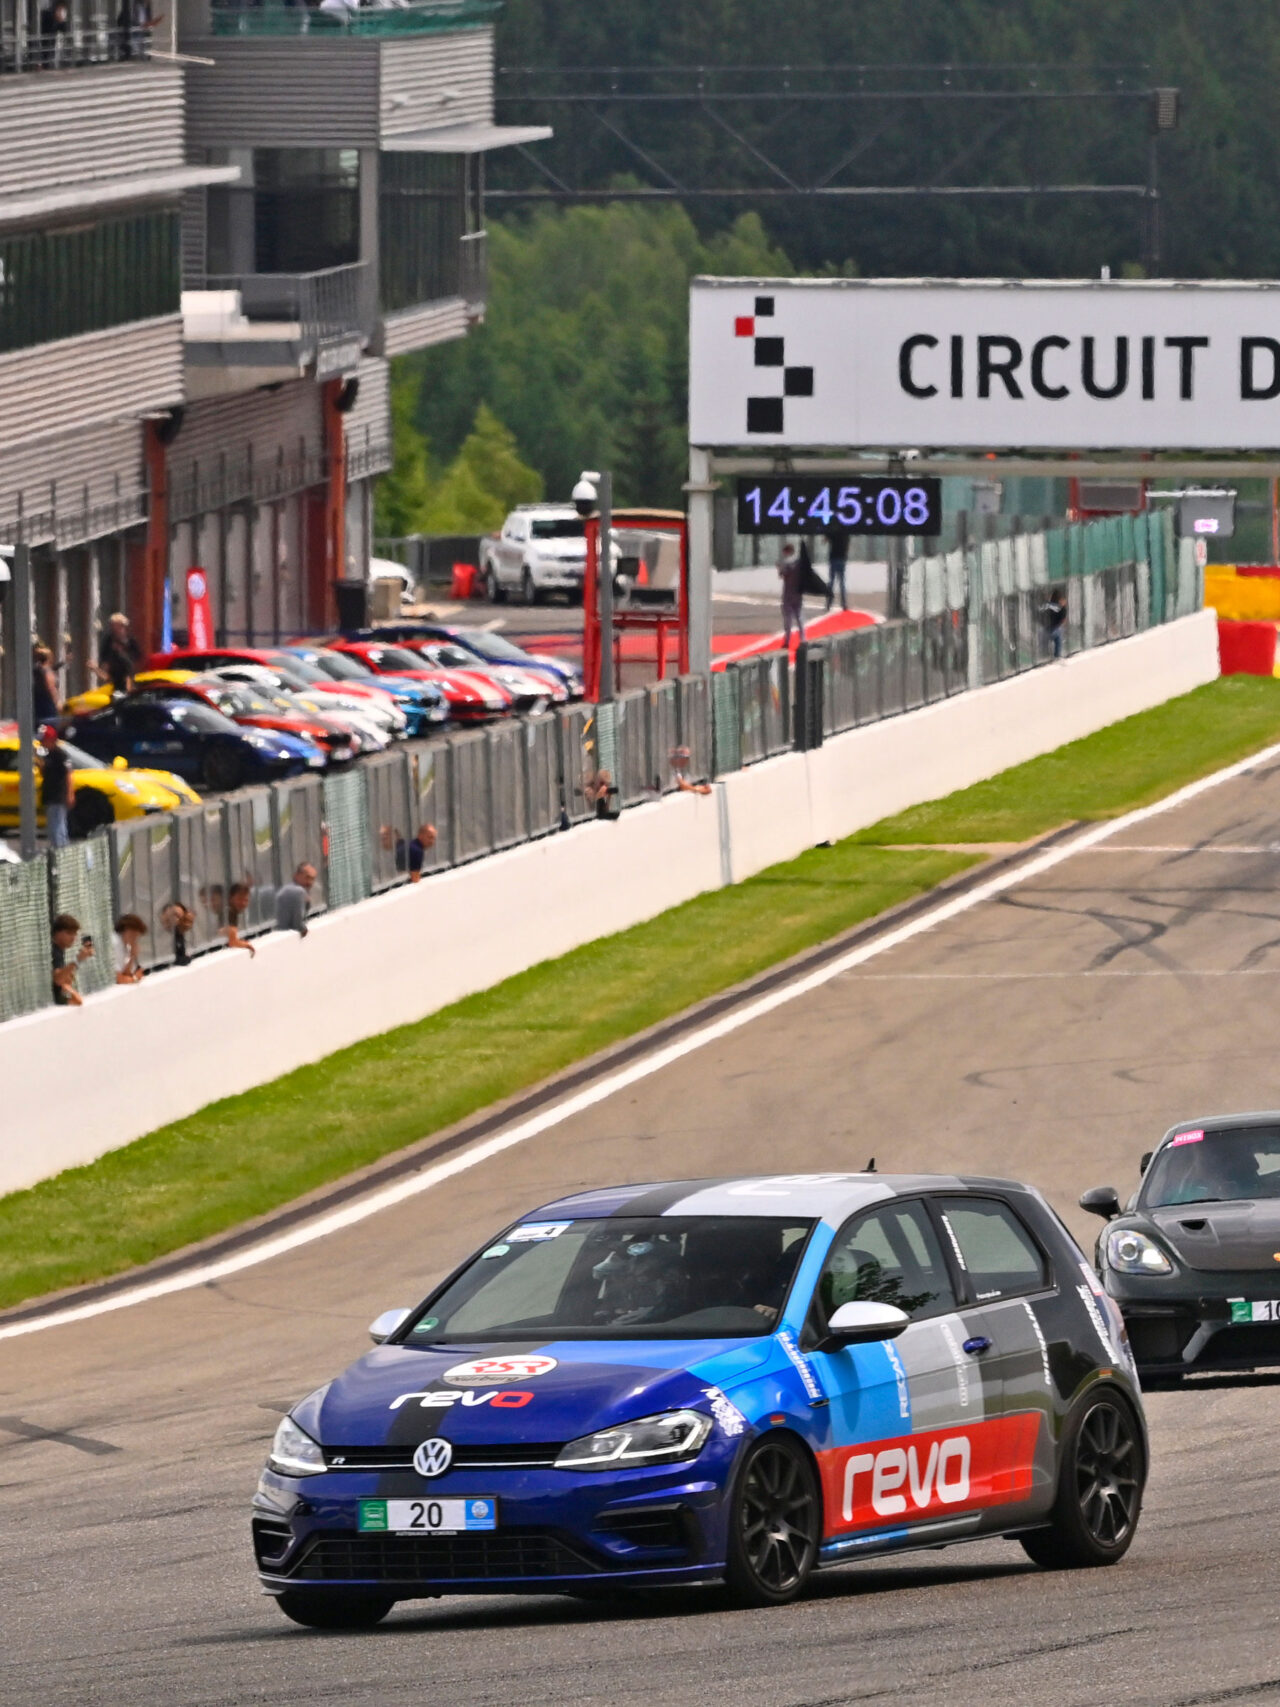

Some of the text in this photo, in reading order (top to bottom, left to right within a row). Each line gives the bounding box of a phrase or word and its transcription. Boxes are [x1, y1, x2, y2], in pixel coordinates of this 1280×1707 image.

[898, 333, 1210, 401] CIRCUIT
[745, 486, 930, 526] 14:45:08
[472, 1360, 551, 1374] RSR
[388, 1390, 535, 1410] revo
[842, 1435, 971, 1522] revo
[410, 1502, 443, 1528] 20
